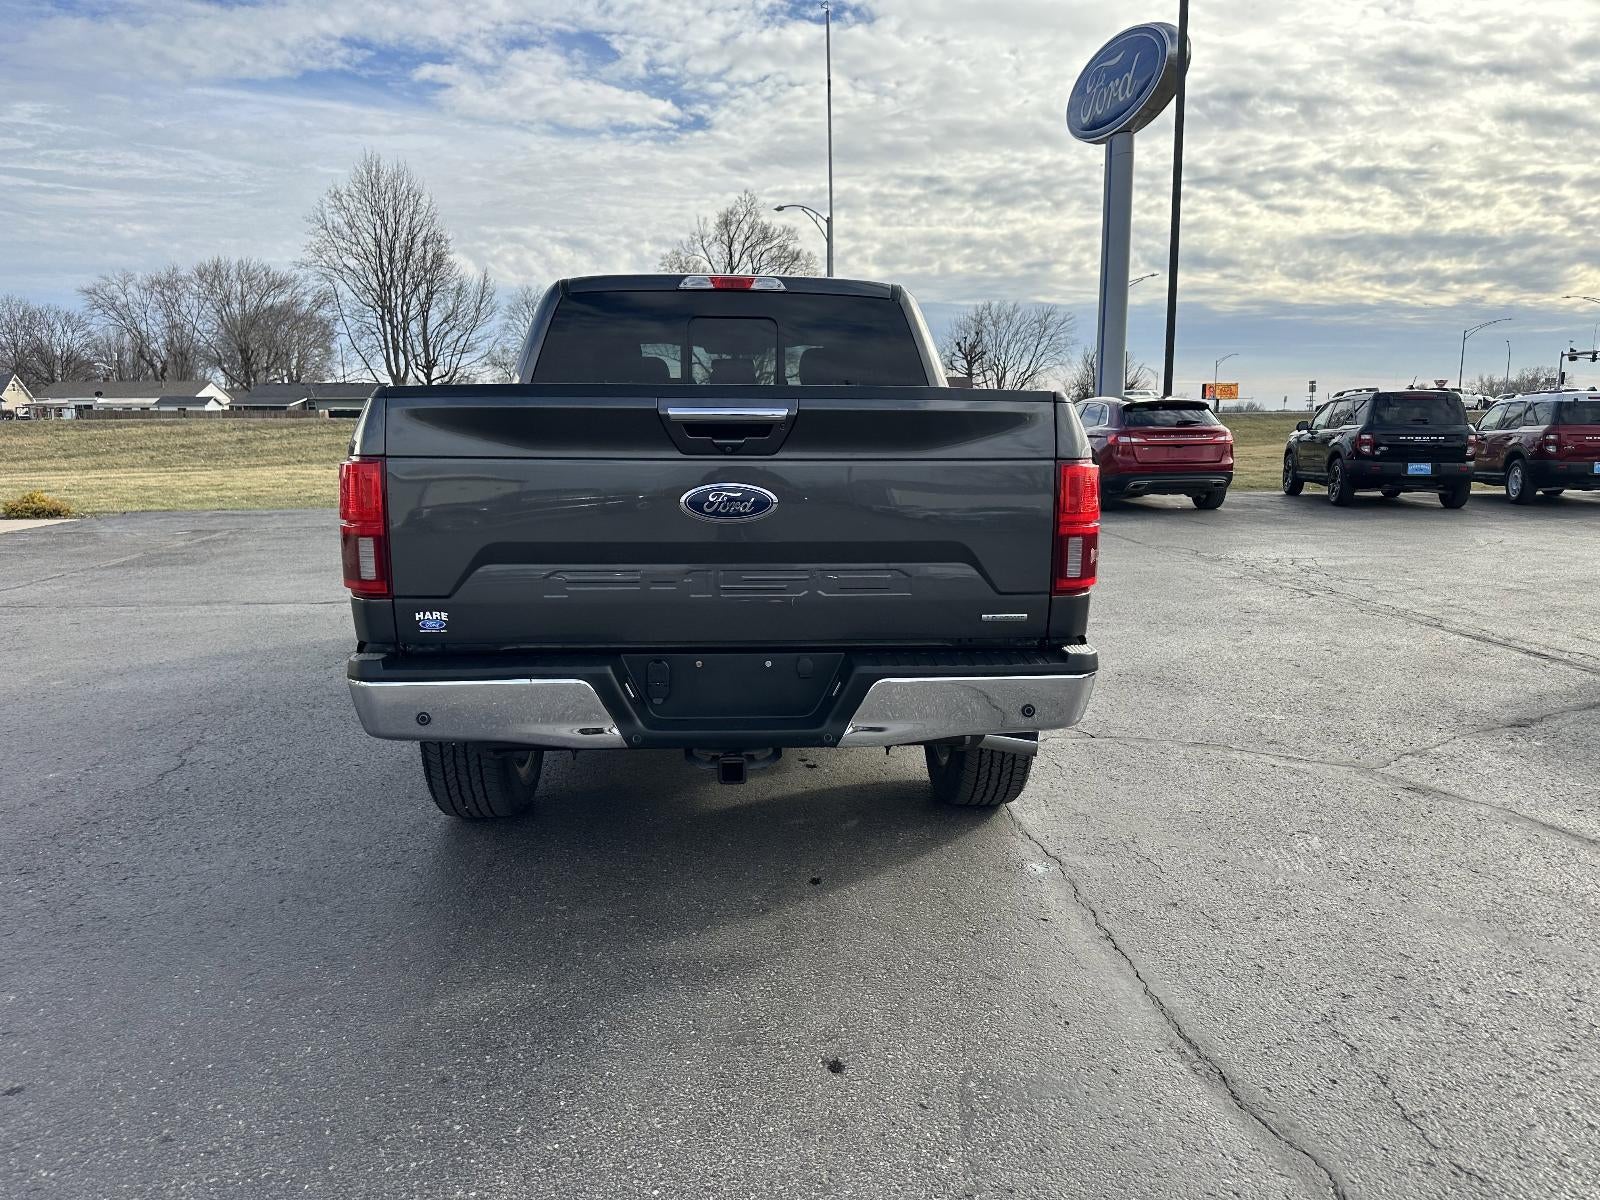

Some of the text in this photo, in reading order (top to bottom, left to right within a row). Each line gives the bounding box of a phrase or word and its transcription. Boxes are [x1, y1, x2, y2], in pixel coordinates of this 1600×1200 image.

[1080, 50, 1141, 124] Ford
[703, 491, 755, 513] Ford
[543, 569, 912, 598] F-150
[415, 611, 449, 621] HARE
